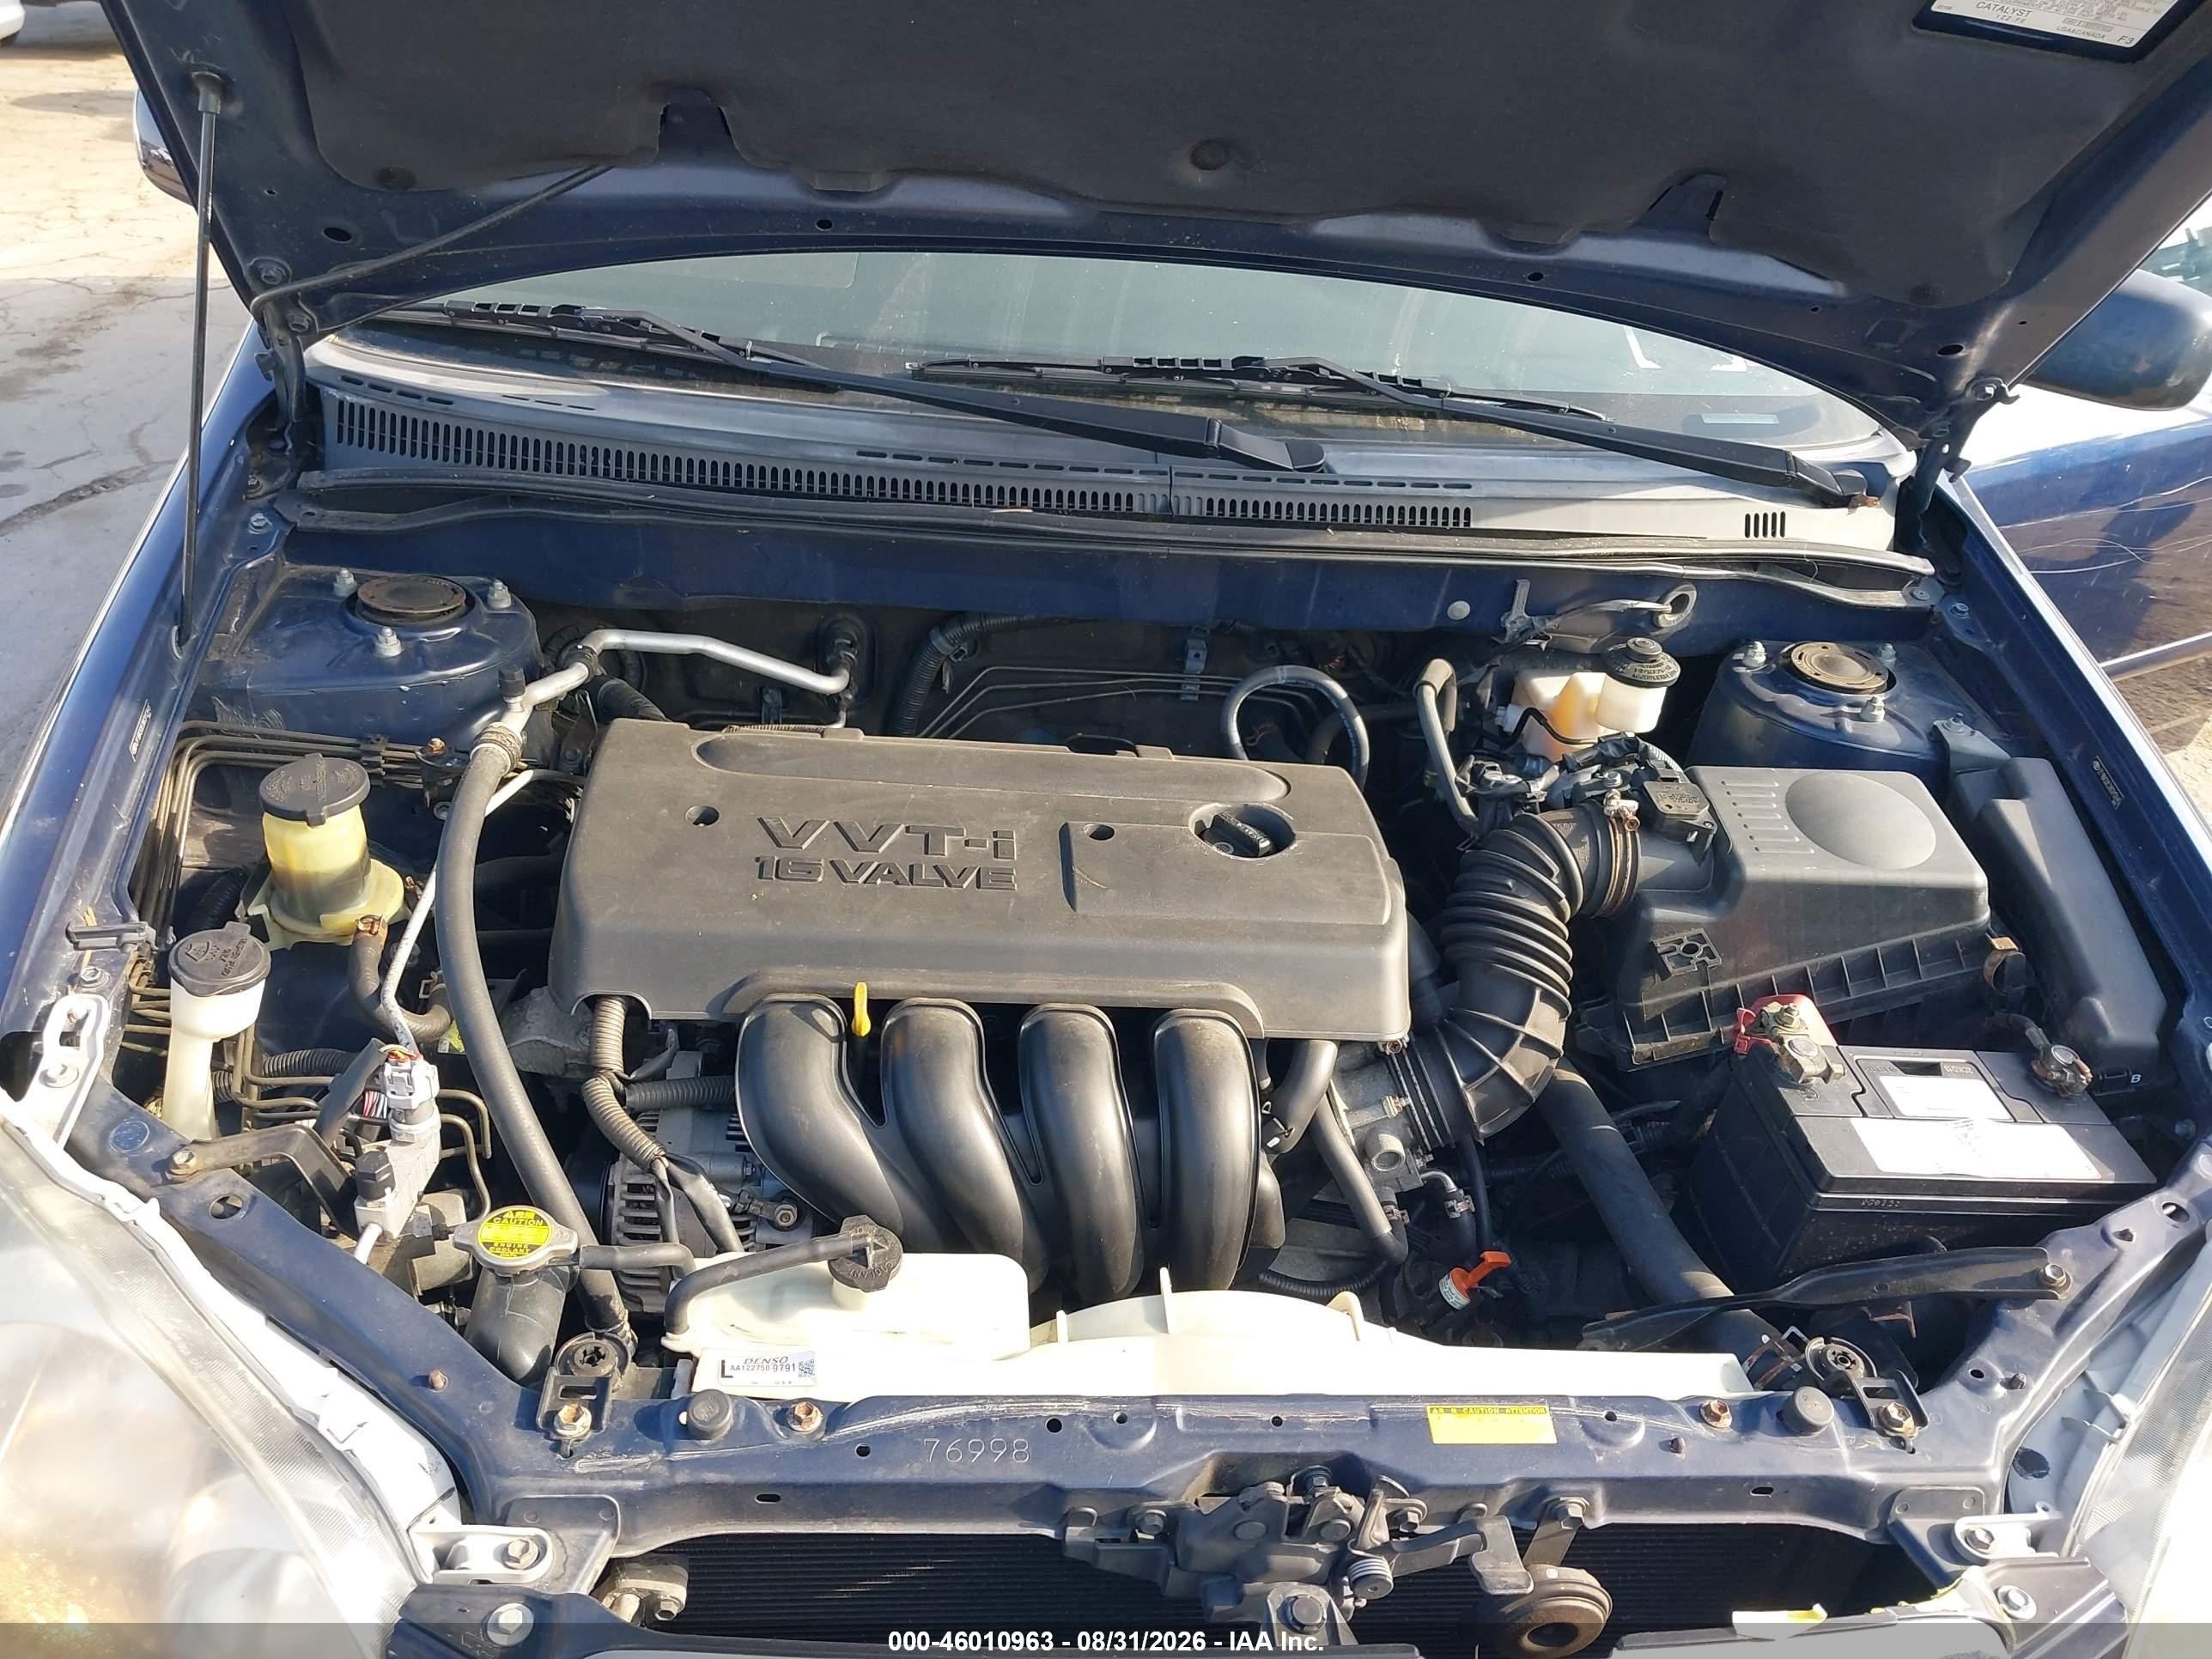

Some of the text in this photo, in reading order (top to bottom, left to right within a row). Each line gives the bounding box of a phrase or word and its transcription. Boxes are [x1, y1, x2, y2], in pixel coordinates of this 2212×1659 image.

[1976, 1, 2033, 18] CATALYST
[2118, 35, 2135, 44] F3
[757, 817, 1017, 860] VVT-i
[754, 855, 1017, 891] 16 VALVE
[2130, 1073, 2142, 1084] B
[493, 1217, 544, 1226] CAUTION
[923, 1437, 1030, 1463] 76998
